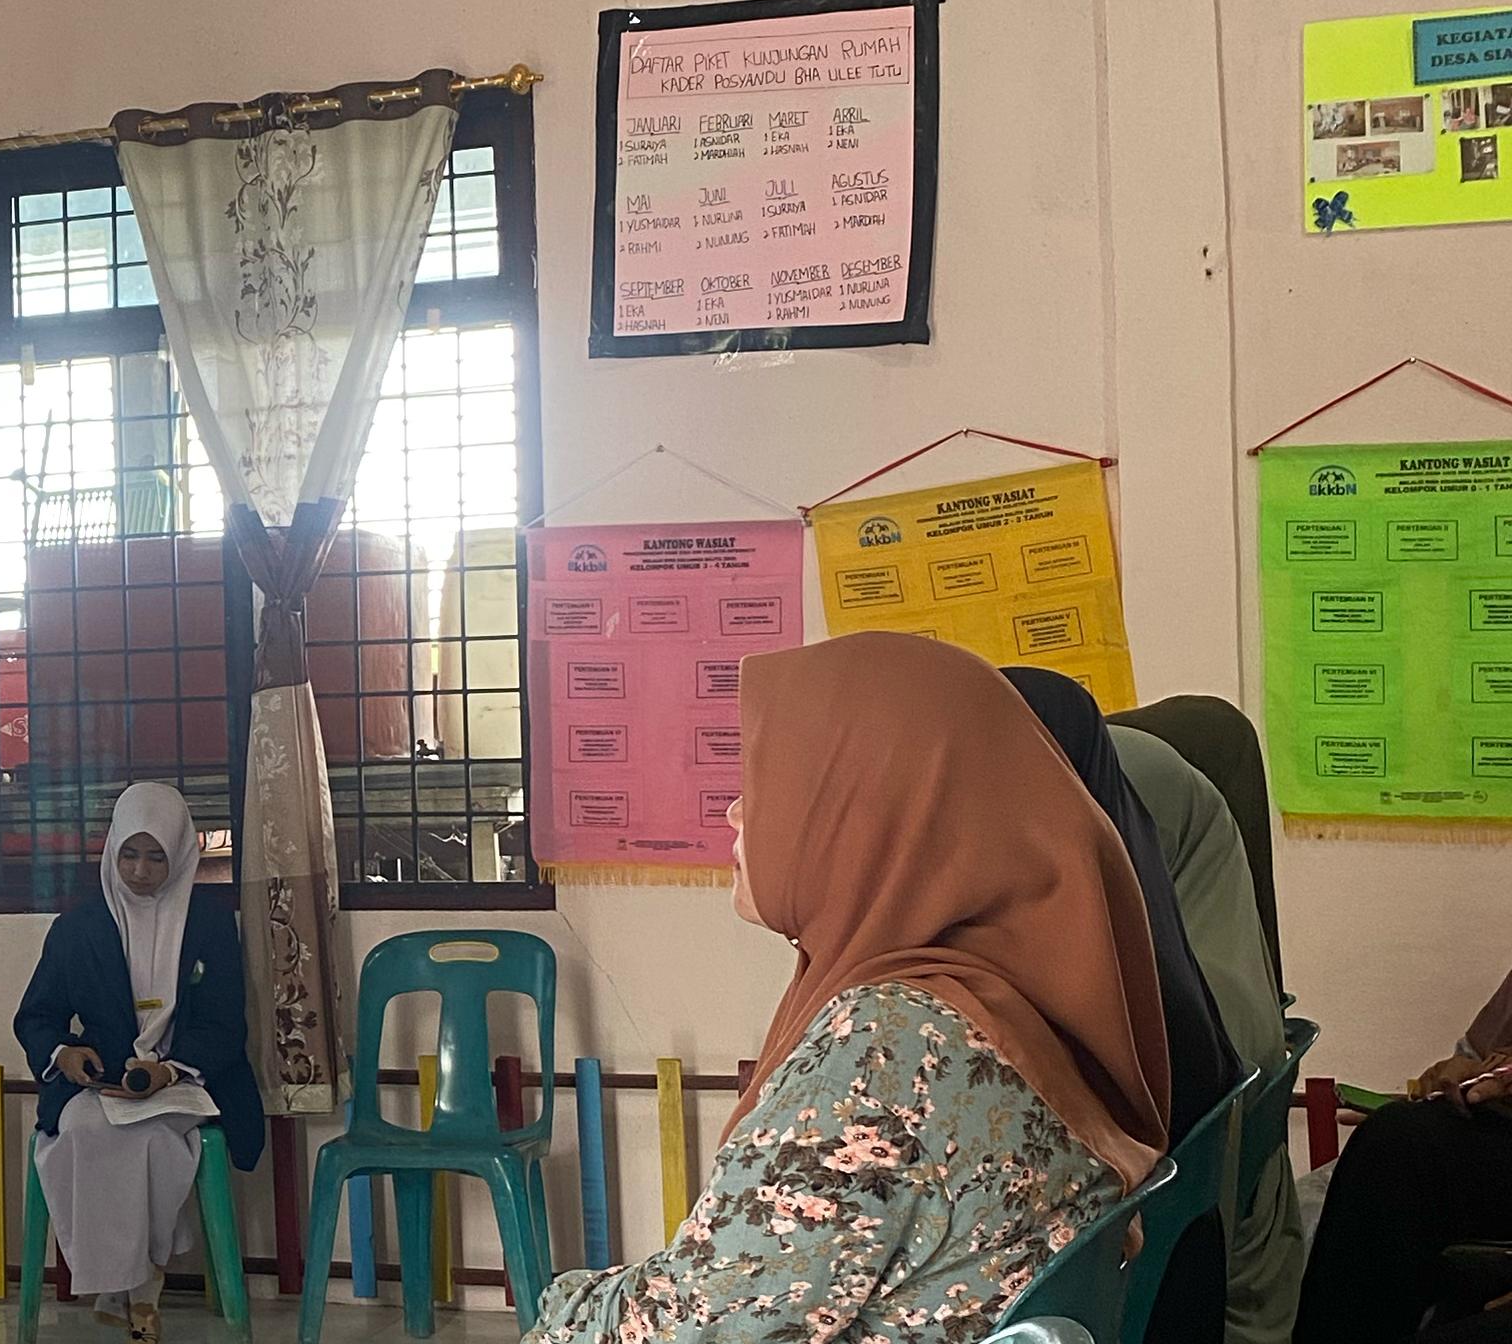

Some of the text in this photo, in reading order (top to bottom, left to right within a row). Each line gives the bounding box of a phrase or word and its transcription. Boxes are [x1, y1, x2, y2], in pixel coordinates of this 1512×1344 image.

[631, 37, 901, 74] DAFTAR PIKET KUNJUNGAN RUMAH
[1431, 50, 1479, 67] DESA
[661, 65, 901, 93] KADER POSYANDU BHA ULEE TUTU
[626, 116, 681, 134] JANUARI
[700, 113, 753, 132] FEBRUARI
[769, 111, 809, 127] MARET
[701, 133, 740, 146] ASNIDAR
[772, 132, 790, 141] EKA
[837, 126, 854, 135] EKA
[628, 154, 668, 165] FATIMAH
[771, 143, 809, 154] HASNAH
[837, 139, 859, 148] NENI
[627, 169, 888, 210] MAI JUNI JULI AGUSTUS
[701, 210, 743, 227] NURLINA
[841, 189, 888, 206] ASNIDAR
[628, 242, 661, 254] RAHMI
[705, 231, 749, 248] NUNUNG
[772, 222, 816, 239] FATIMAH
[620, 255, 902, 298] SEPTEMBER OKTOBER NOVEMBER DESEMBER
[626, 279, 890, 317] EKA EKA YUSMAIDAR NURLINA
[625, 295, 891, 331] HASNAH NENI RAHMI NUNUNG
[1400, 457, 1511, 470] KANTONG WASIAT
[936, 495, 990, 514] KANTONG
[992, 488, 1036, 504] WASIAT
[1310, 484, 1356, 496] BkkbN
[1385, 486, 1437, 494] KELOMPOK
[644, 537, 736, 550] KANTONG WASIAT
[927, 525, 974, 538] KELOMPOK
